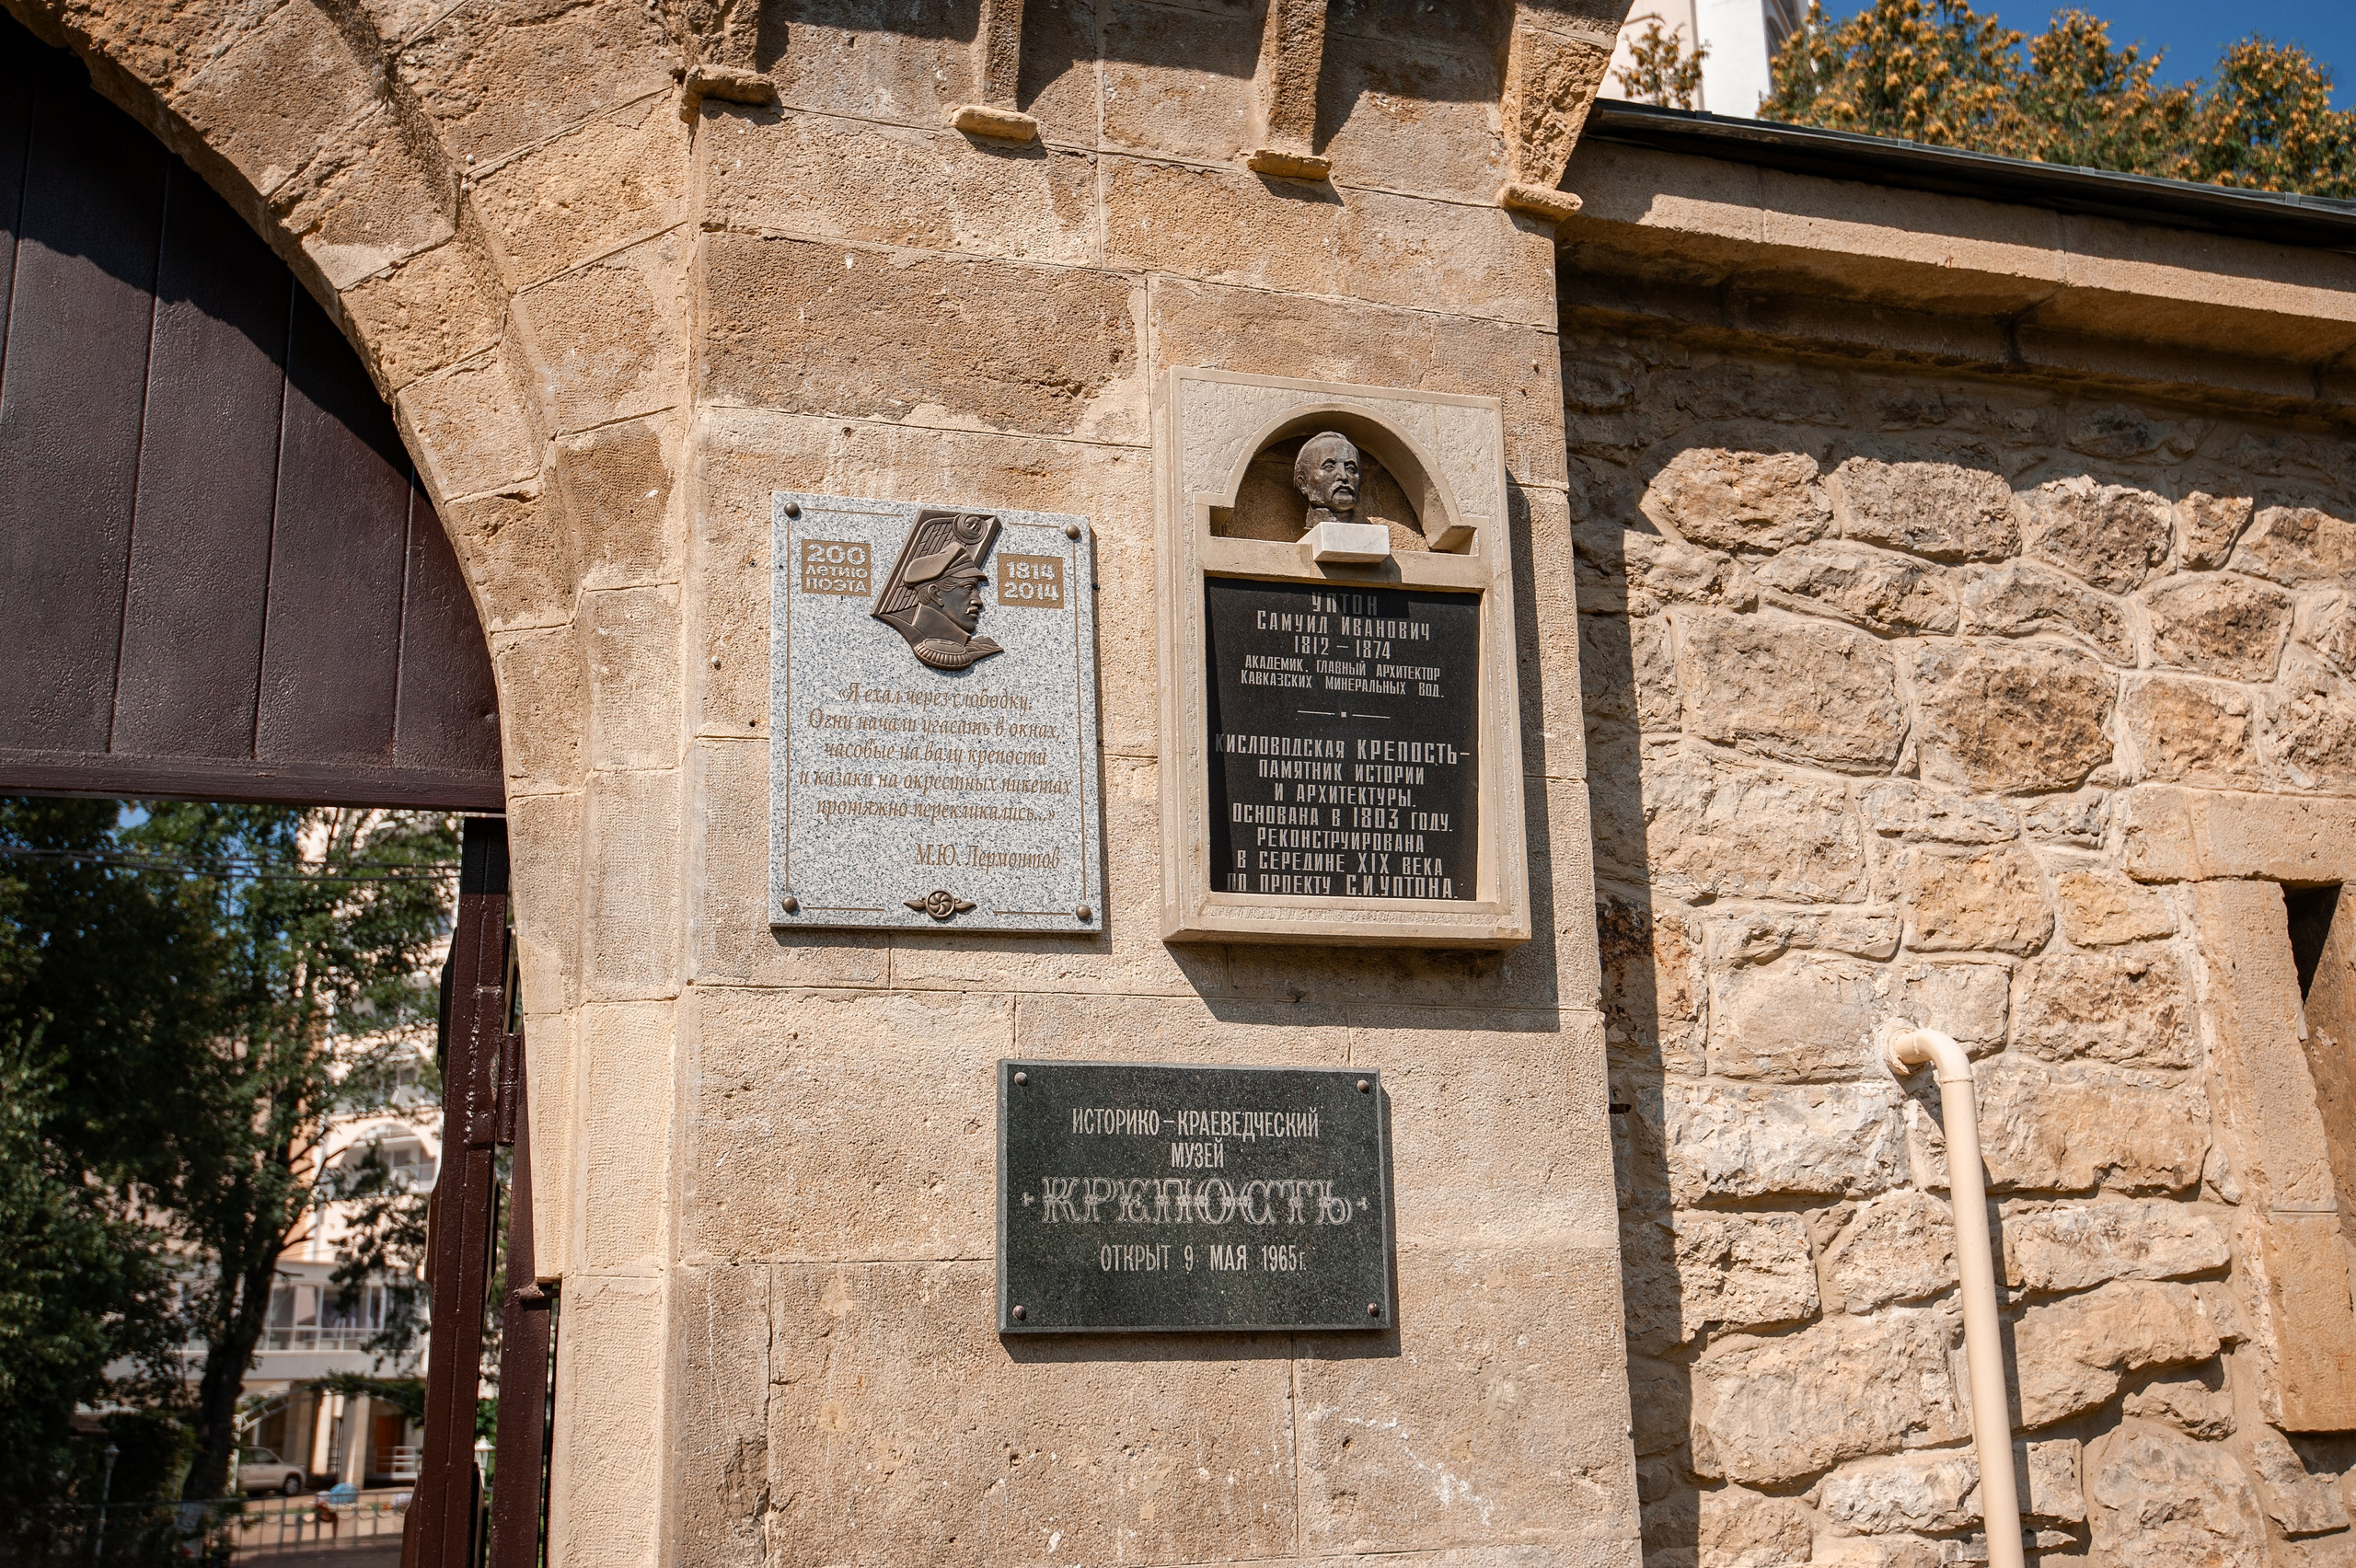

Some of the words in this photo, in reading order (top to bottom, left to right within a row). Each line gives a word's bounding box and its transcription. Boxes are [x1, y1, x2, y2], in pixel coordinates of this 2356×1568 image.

[807, 543, 866, 565] 200
[805, 564, 868, 579] летию
[1007, 561, 1056, 581] 1814
[806, 577, 867, 594] ПОЭТА
[1003, 581, 1059, 601] 2014
[1311, 592, 1378, 616] УПТОН
[1257, 610, 1328, 634] САМУИЛ
[1341, 616, 1430, 640] ИВАНОВИЧ
[1295, 635, 1329, 655] 1812
[1356, 639, 1391, 660] 1874
[1241, 669, 1312, 688] КАВКАЗСКИХ
[1325, 675, 1406, 696] МИНЕРАЛЬНЫХ
[1418, 682, 1444, 698] ВОД.
[1316, 660, 1366, 676] ГЛАВНЫЙ
[1376, 663, 1440, 681] АРХИТЕКТОР
[838, 682, 860, 702] «Я
[864, 688, 901, 704] ехал
[906, 691, 949, 712] через
[809, 708, 853, 730] Огни
[858, 714, 918, 732] начали
[921, 719, 991, 740] угасать
[995, 716, 1005, 737] в
[1009, 722, 1060, 743] окнах,
[825, 738, 895, 760] часовые
[899, 744, 919, 761] на
[924, 740, 964, 768] валу
[967, 748, 1047, 771] крепости
[1215, 733, 1345, 759] КИСЛОВОДСКАЯ
[799, 770, 810, 785] и
[814, 771, 873, 788] казаки
[877, 773, 898, 789] на
[903, 774, 997, 797] окрестных
[1258, 759, 1343, 782] ПАМЯТНИК
[1355, 764, 1425, 785] ИСТОРИИ
[1274, 782, 1284, 801] И
[1296, 784, 1417, 808] АРХИТЕКТУРЫ.
[816, 800, 908, 822] протяжно
[1231, 802, 1319, 826] ОСНОВАНА
[1332, 808, 1341, 827] В
[1353, 808, 1399, 830] 1803
[1411, 812, 1453, 832] ГОДУ.
[1257, 826, 1425, 853] РЕКОНСТРУИРОВАНА
[915, 844, 961, 867] М.Ю.
[966, 845, 1061, 874] Лермонтов
[1237, 849, 1246, 869] В
[1259, 851, 1345, 872] СЕРЕДИНЕ
[1403, 857, 1443, 876] ВЕКА
[1227, 872, 1247, 893] ПО
[1260, 873, 1332, 895] ПРОЕКТУ
[1171, 1137, 1224, 1169] МУЗЕЙ
[1042, 1176, 1353, 1225] КРЕПОСТЬ
[1100, 1244, 1171, 1272] ОТКРЫТ
[1184, 1245, 1194, 1272] 9
[1209, 1245, 1247, 1272] МАЯ
